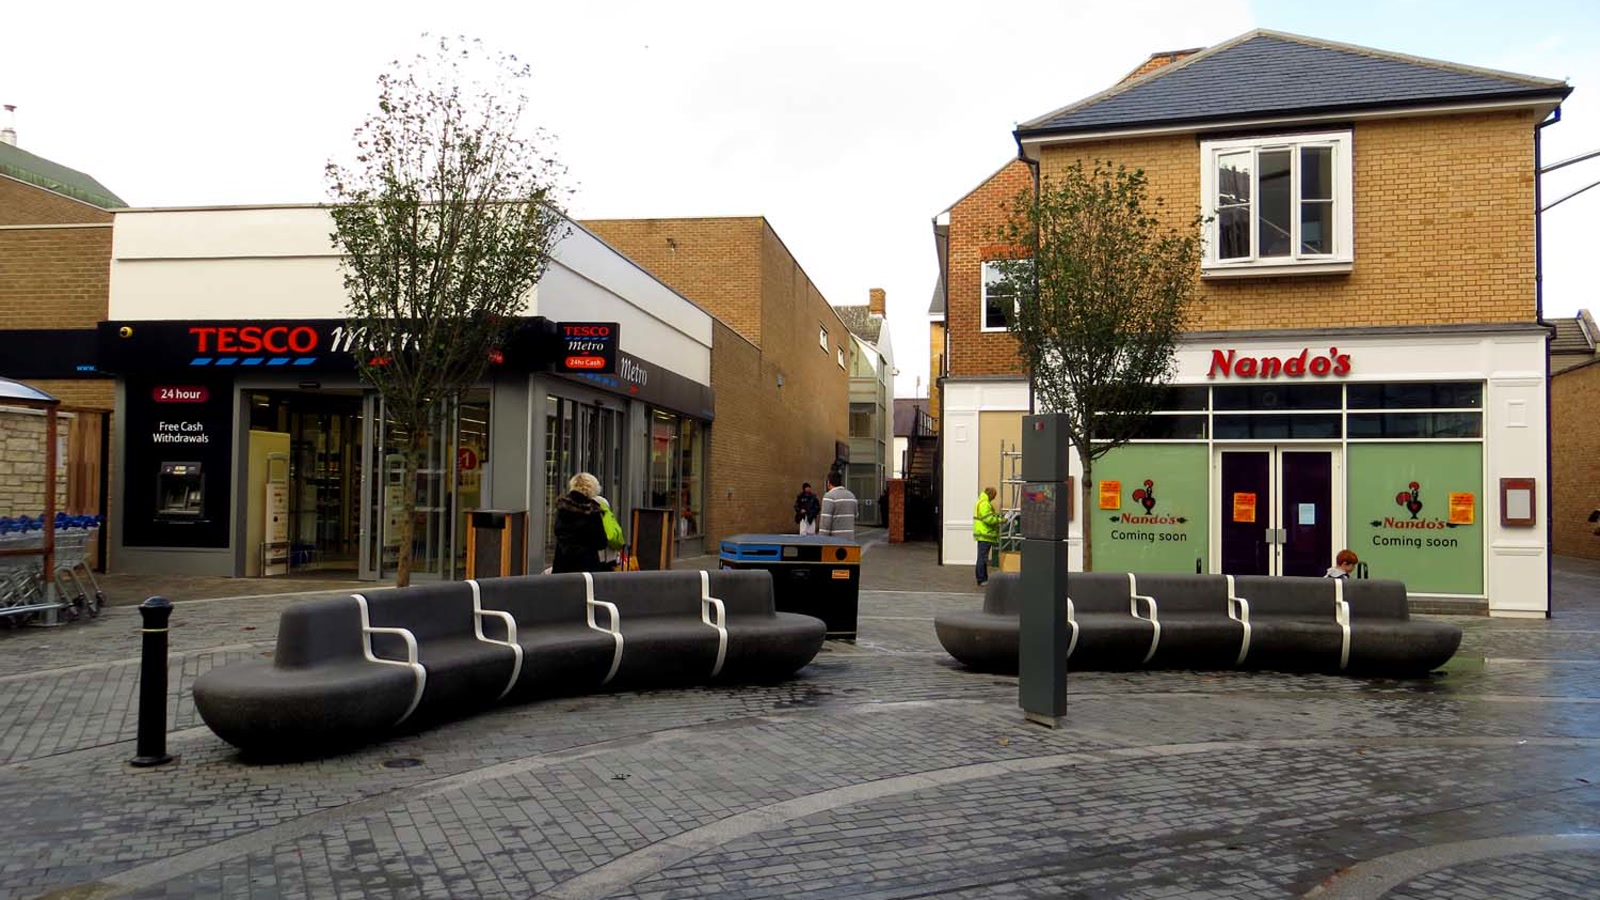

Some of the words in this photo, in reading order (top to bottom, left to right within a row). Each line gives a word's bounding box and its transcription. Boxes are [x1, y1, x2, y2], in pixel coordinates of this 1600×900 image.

[563, 326, 610, 337] TESCO
[189, 326, 319, 353] TESCO
[568, 341, 604, 351] Metro
[570, 359, 584, 367] 24hr
[585, 359, 602, 367] Cash
[1207, 346, 1351, 379] Nando's
[620, 357, 648, 386] Metro
[161, 388, 174, 399] 24
[176, 388, 201, 399] hour
[159, 421, 180, 431] Free
[181, 421, 203, 431] Cash
[152, 433, 209, 443] Withdrawals
[1120, 513, 1177, 525] Nando's
[1383, 517, 1445, 530] Nando's
[1111, 530, 1155, 543] Coming
[1159, 532, 1187, 542] soon
[1372, 535, 1422, 548] Coming
[1426, 538, 1458, 548] soon
